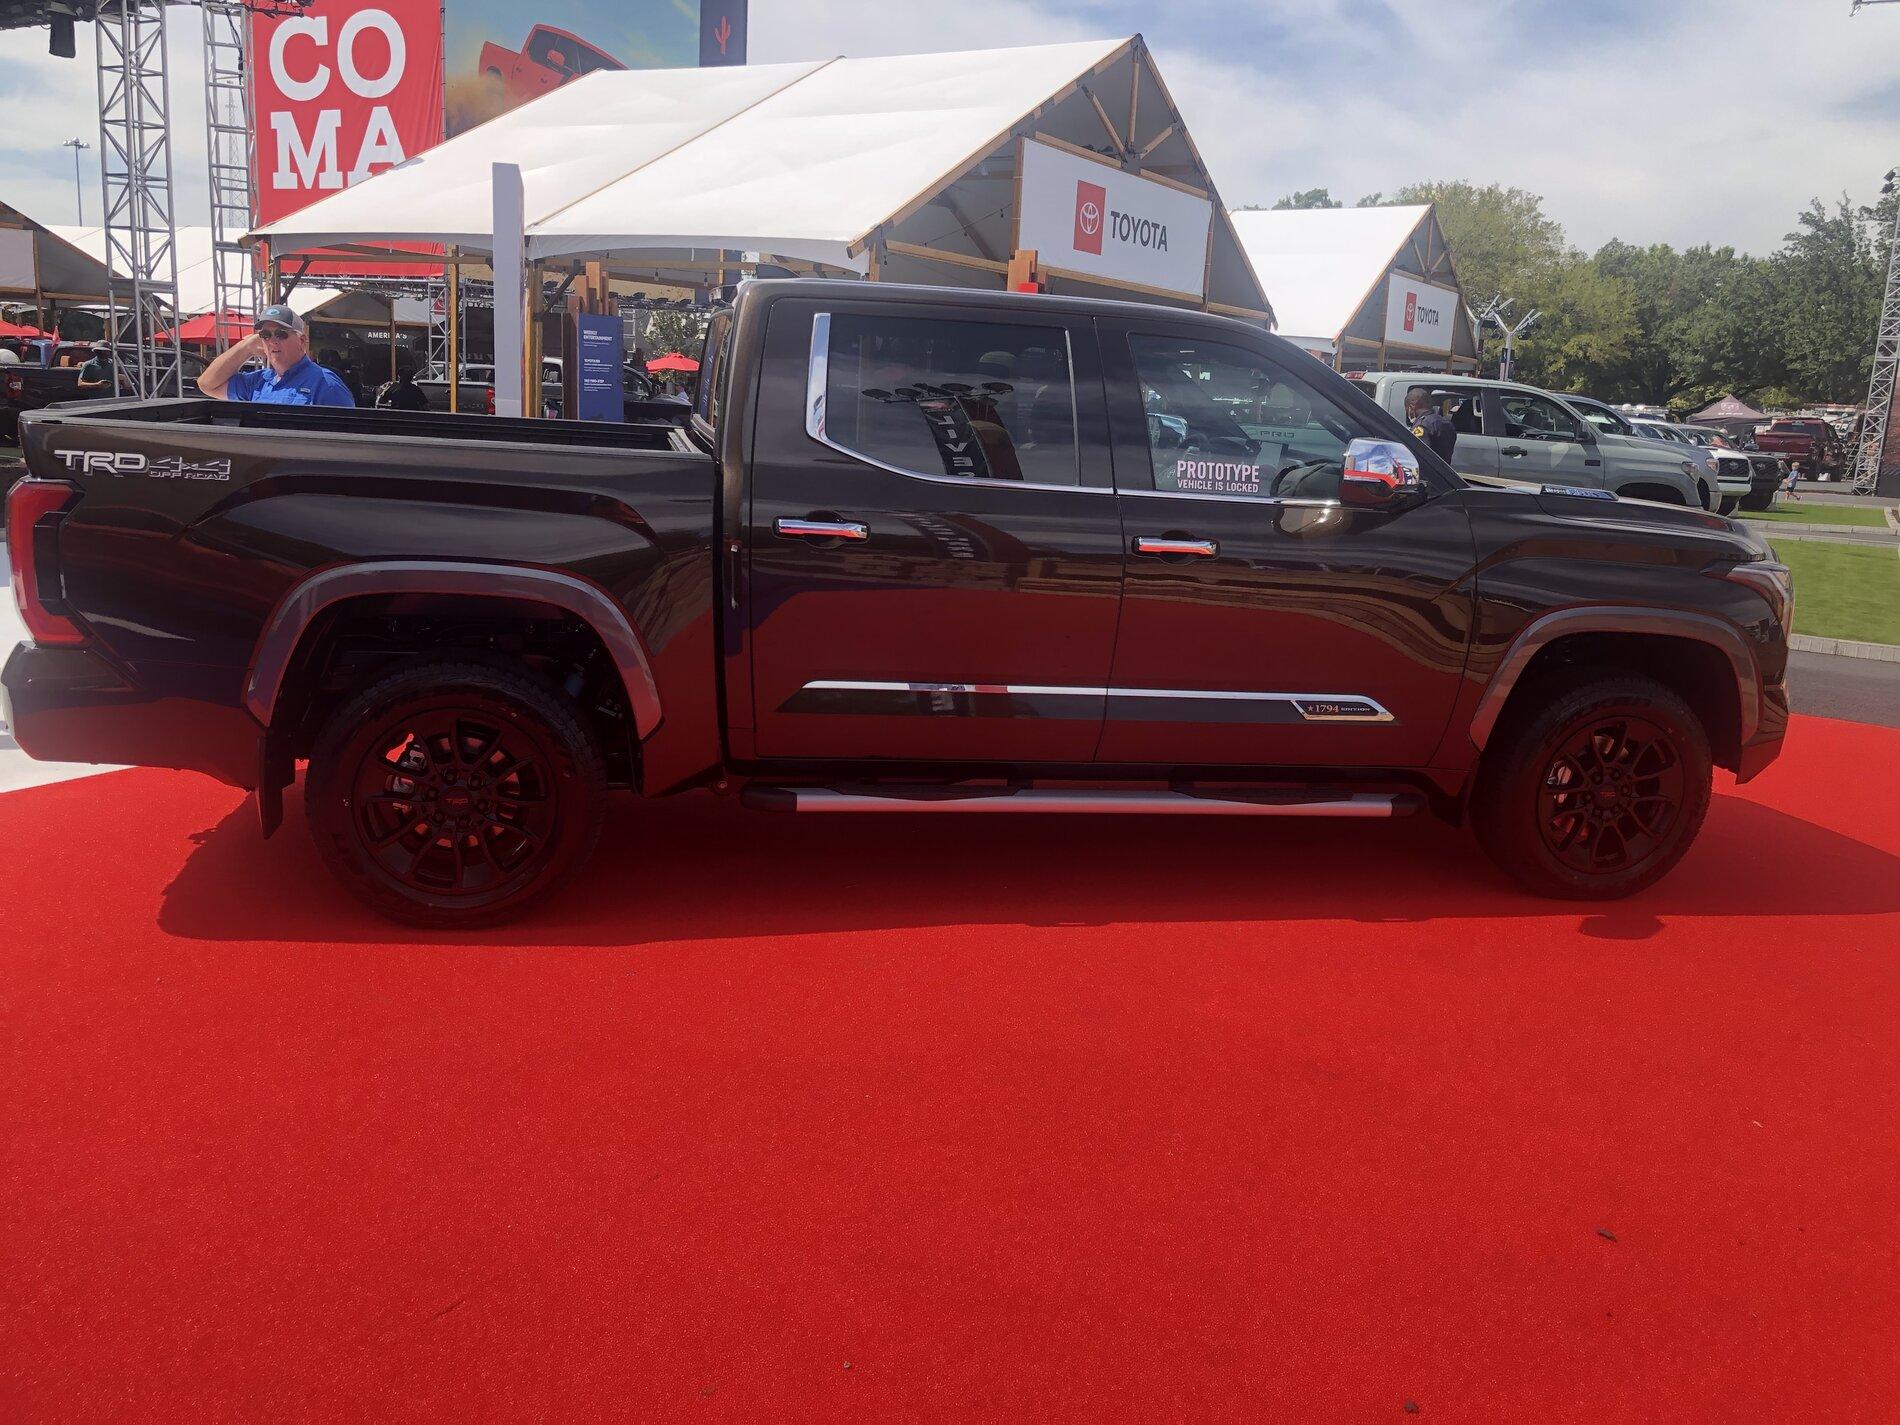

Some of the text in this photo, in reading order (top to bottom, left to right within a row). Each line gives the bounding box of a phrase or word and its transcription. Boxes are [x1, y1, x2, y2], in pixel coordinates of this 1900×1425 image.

[269, 9, 406, 101] CO
[270, 106, 407, 190] MA
[1110, 210, 1168, 252] TOYOTA
[1417, 305, 1439, 327] TOYOTA
[367, 331, 408, 340] AMERIA'S
[1260, 430, 1295, 439] PRO
[54, 450, 149, 477] TRD
[1176, 460, 1260, 482] PROTOTYPE
[150, 471, 231, 482] OFF ROAD
[1177, 479, 1259, 493] VEHICLE IS LOCKED
[1315, 704, 1340, 713] 1794
